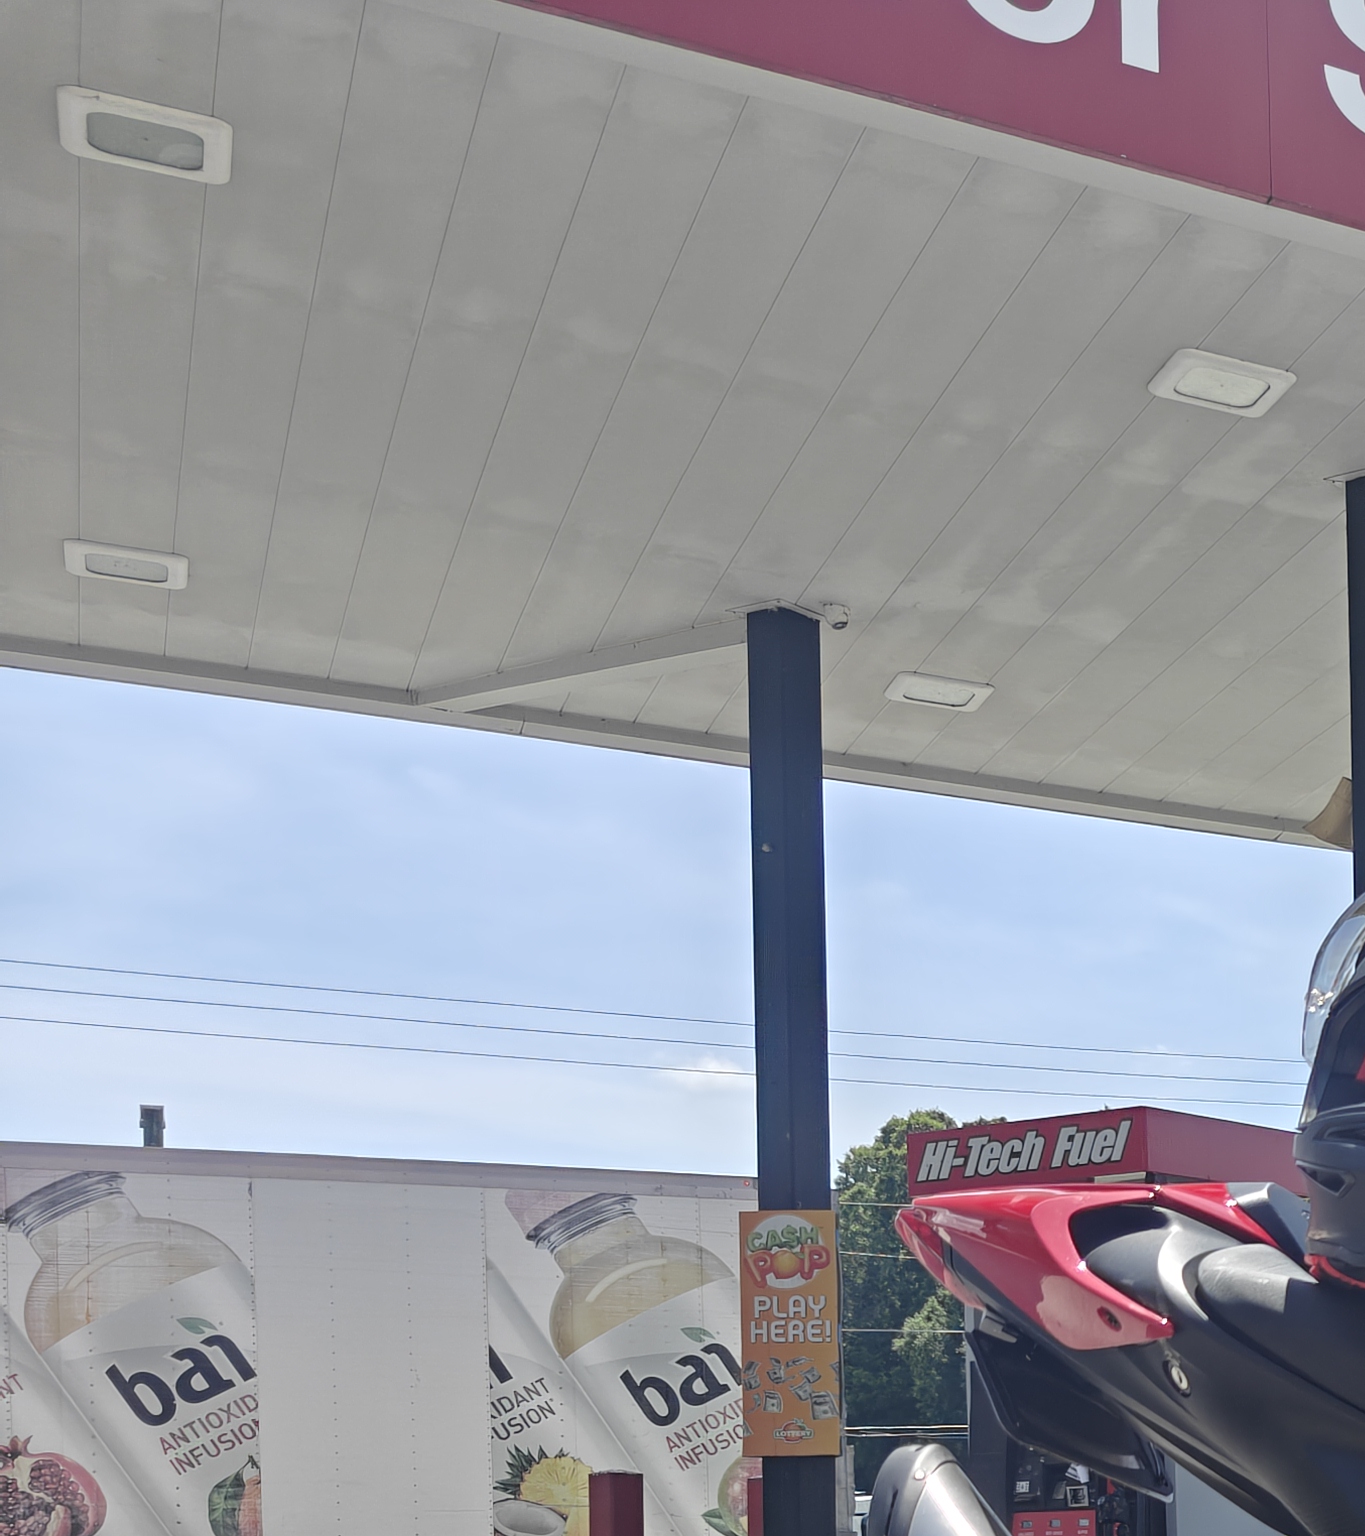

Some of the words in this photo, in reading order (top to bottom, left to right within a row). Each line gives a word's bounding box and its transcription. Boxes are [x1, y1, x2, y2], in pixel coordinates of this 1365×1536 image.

[916, 1130, 1046, 1182] Hi-Tech
[1050, 1119, 1132, 1168] Fuel
[753, 1295, 826, 1319] PLAY
[750, 1319, 833, 1344] HERE!
[491, 1405, 557, 1441] USION
[775, 1429, 814, 1439] LOTTERY
